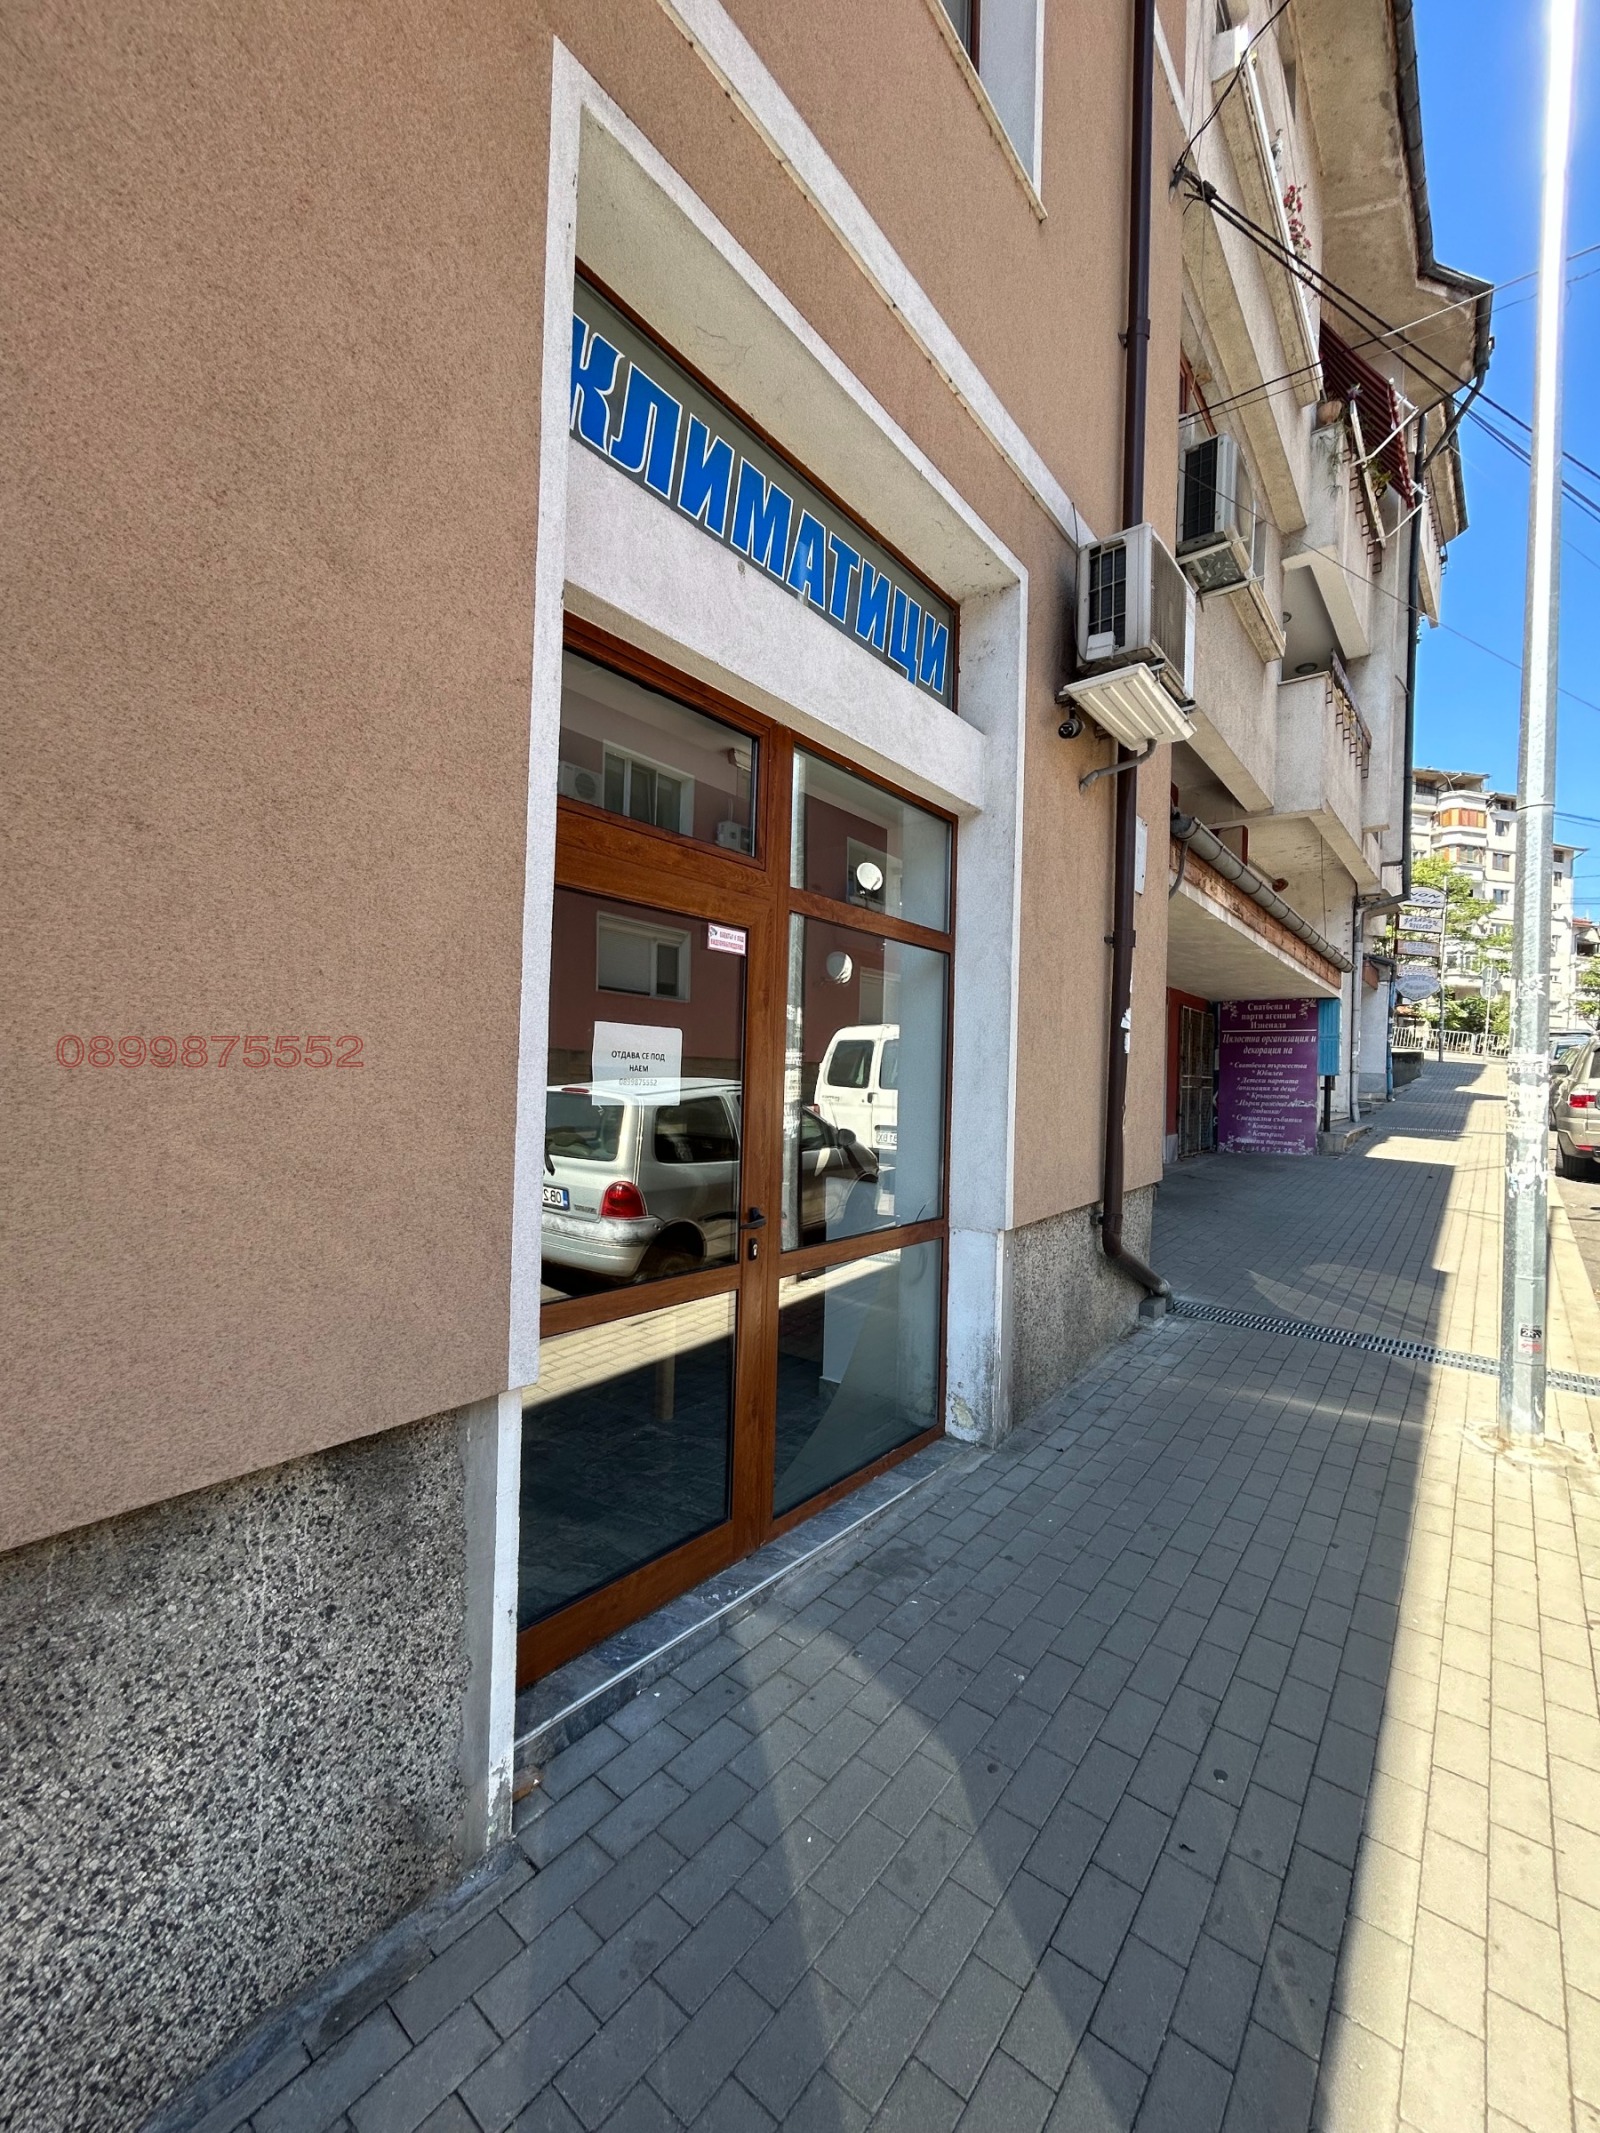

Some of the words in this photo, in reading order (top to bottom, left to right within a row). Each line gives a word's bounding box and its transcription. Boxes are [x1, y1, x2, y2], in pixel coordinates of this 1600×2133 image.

[571, 313, 949, 696] КЛИМАТИЦИ
[1247, 1003, 1283, 1011] Сватбена
[611, 1050, 640, 1060] ОТДАВА
[642, 1052, 649, 1060] СЕ
[651, 1053, 666, 1062] ПОД
[629, 1064, 648, 1072] НАЕМ
